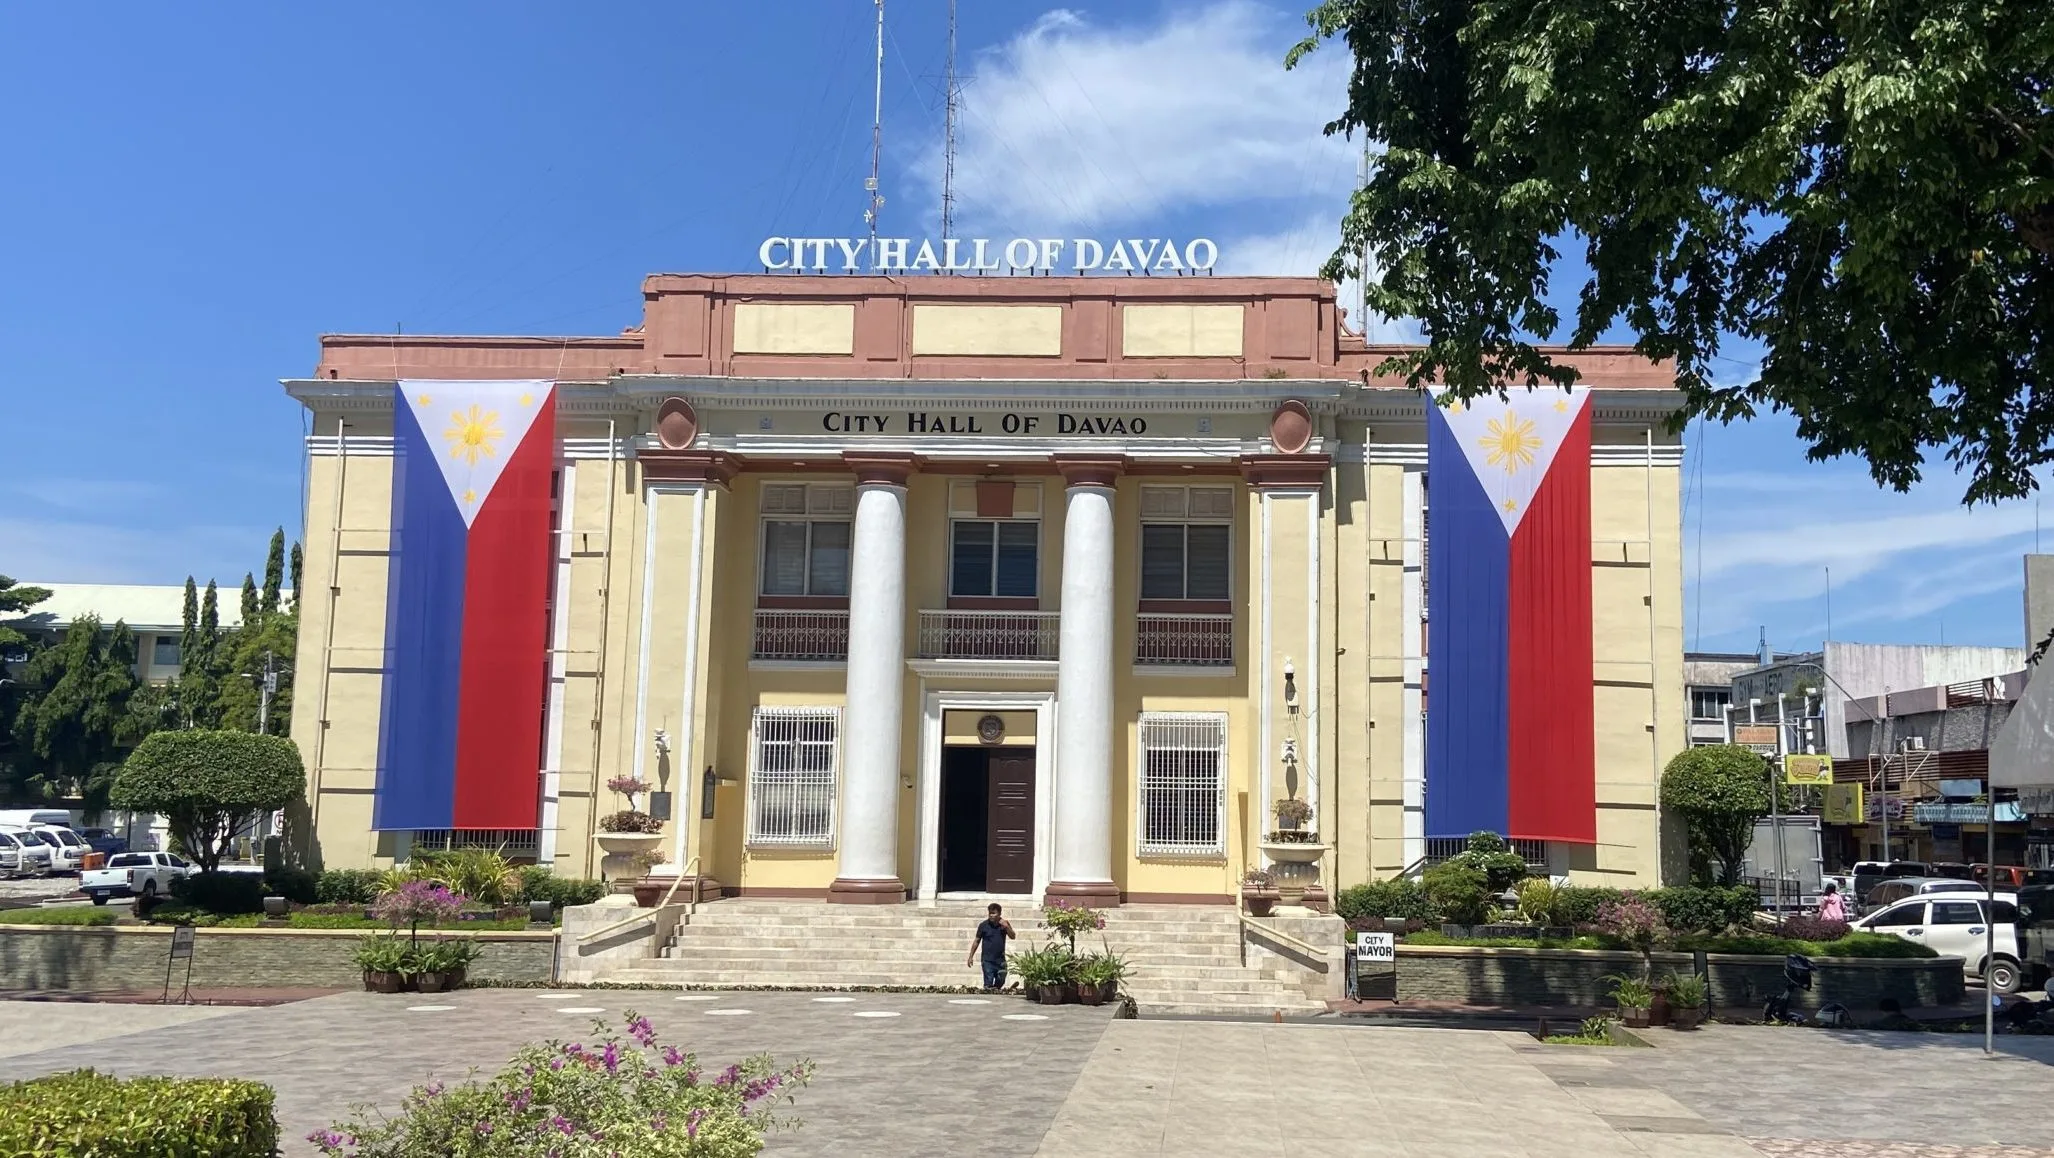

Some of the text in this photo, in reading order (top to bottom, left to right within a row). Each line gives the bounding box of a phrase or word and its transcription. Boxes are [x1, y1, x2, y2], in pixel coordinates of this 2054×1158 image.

[759, 236, 1218, 270] CITY HALL OF DAVAO
[822, 412, 1148, 434] CITY HALL OF DAVAO
[1365, 936, 1384, 944] CITY
[1358, 946, 1392, 957] MAYOR
